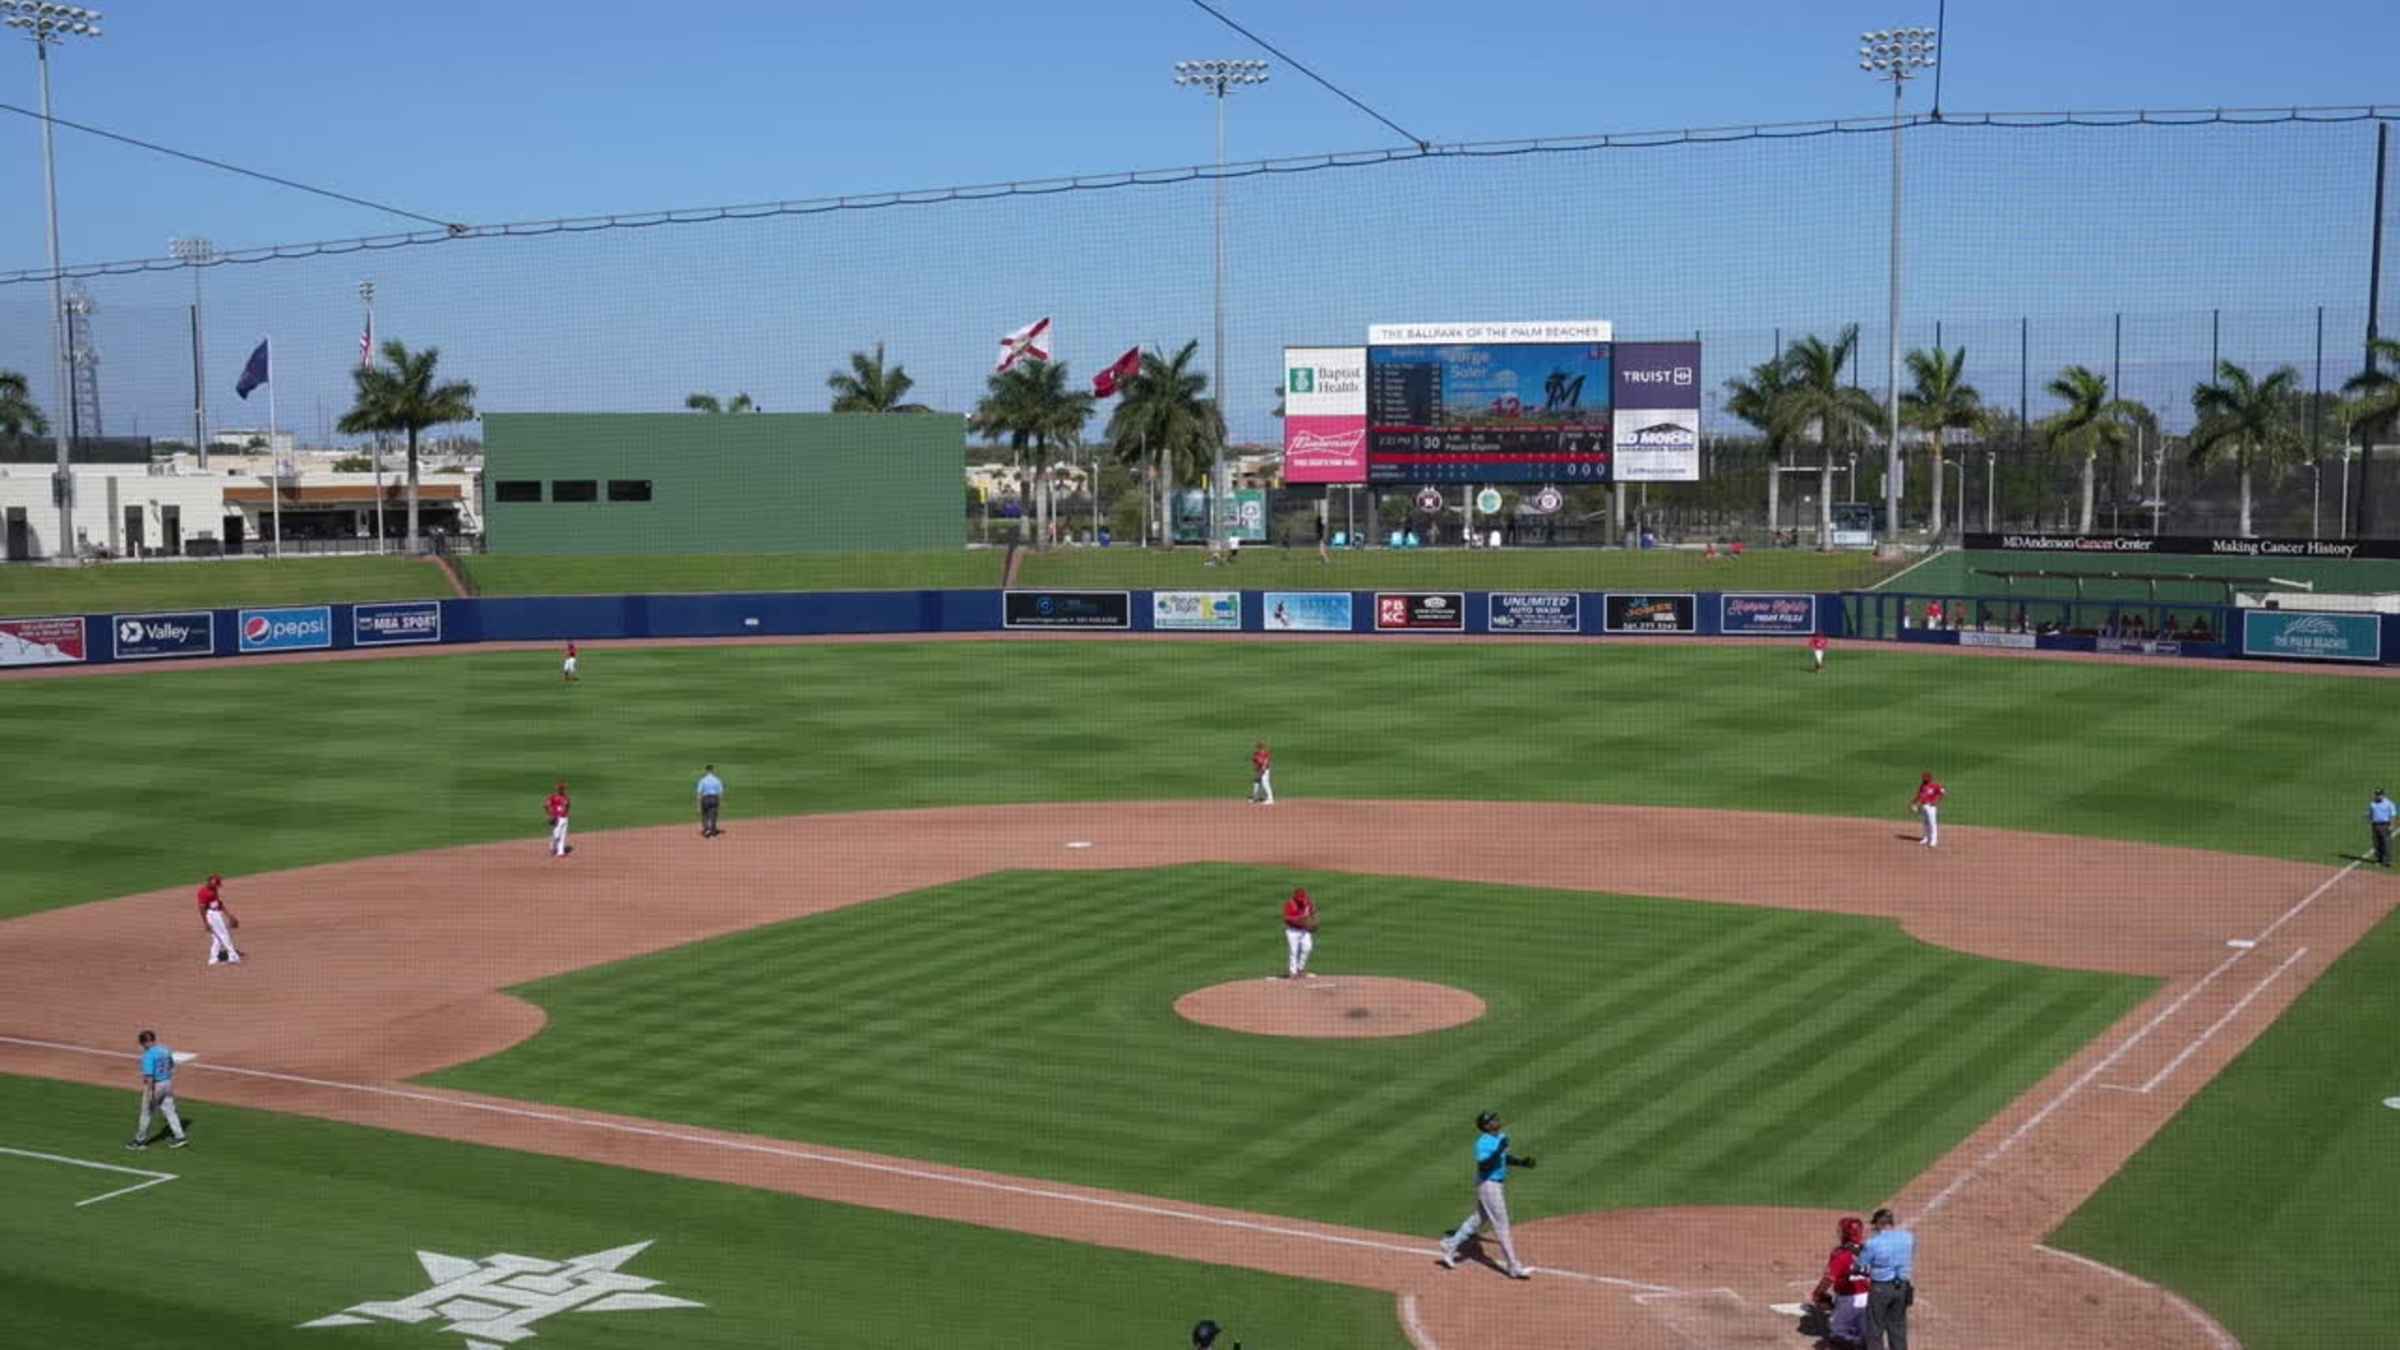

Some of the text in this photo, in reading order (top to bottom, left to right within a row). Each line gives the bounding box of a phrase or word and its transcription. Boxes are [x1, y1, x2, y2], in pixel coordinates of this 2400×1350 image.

[1382, 326, 1599, 340] THE BALLPARK OF THE PALM BEACHES
[1318, 367, 1361, 381] Baptist
[1623, 370, 1672, 383] TRUIST
[1318, 381, 1359, 393] Health
[1423, 436, 1440, 450] 30
[1566, 463, 1606, 476] 0 0 0
[2075, 538, 2114, 549] Cancer
[2114, 539, 2152, 550] Center
[2212, 539, 2357, 561] Making Cancer History
[1382, 599, 1404, 611] PB
[1503, 597, 1570, 607] UNLIMITED
[1382, 611, 1404, 623] KC
[1535, 607, 1561, 615] WASH
[145, 624, 190, 643] Valley
[273, 616, 326, 640] pepsi
[2290, 636, 2313, 648] PALM
